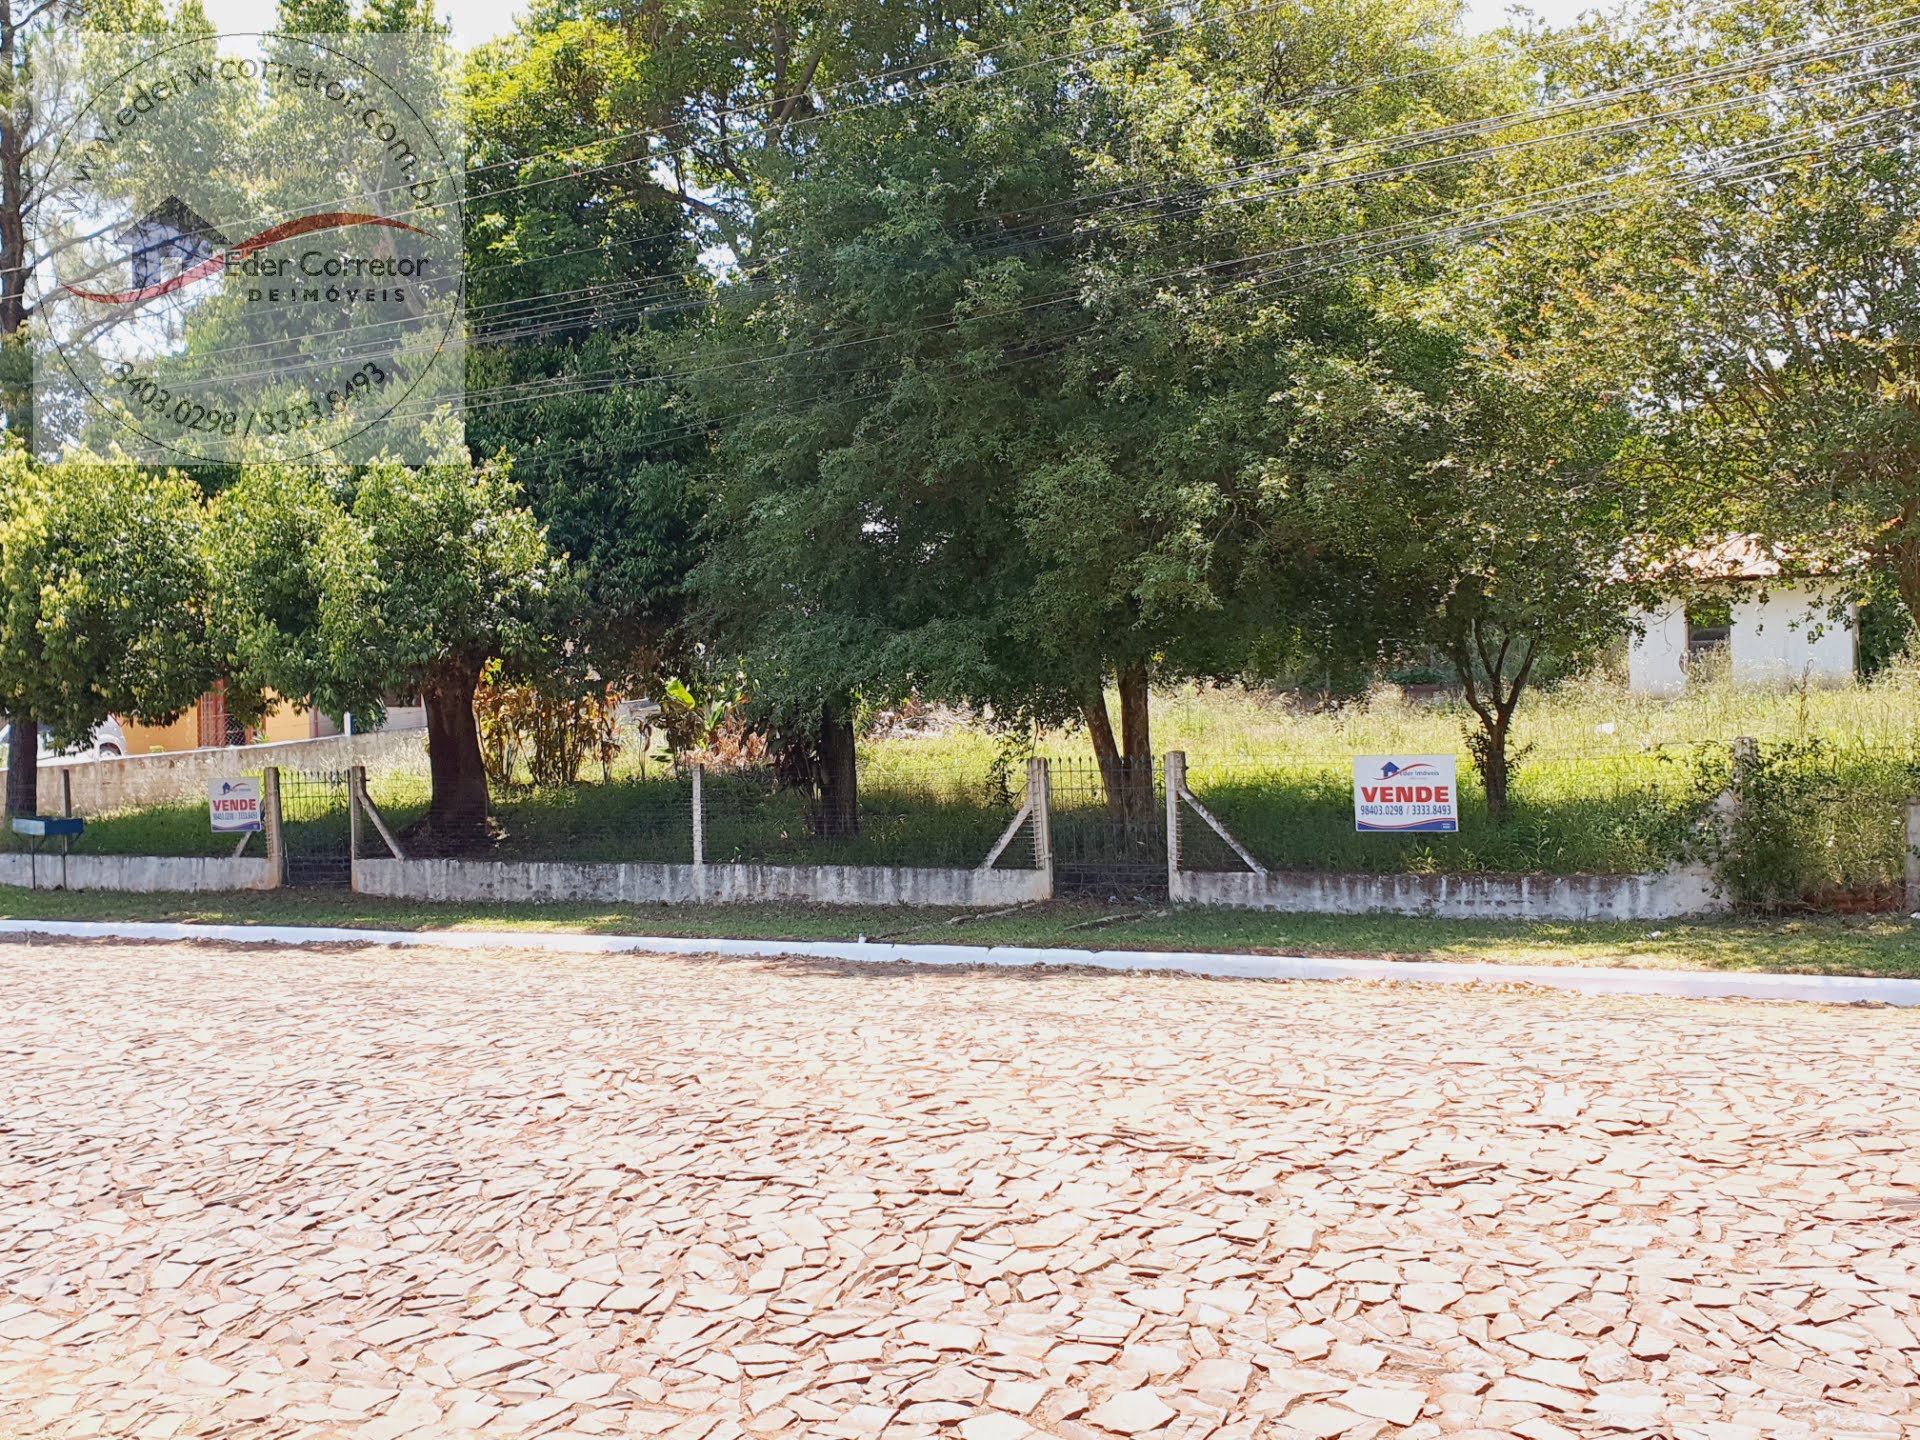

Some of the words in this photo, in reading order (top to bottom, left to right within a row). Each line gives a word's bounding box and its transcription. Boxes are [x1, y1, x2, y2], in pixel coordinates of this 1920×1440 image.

[1361, 786, 1450, 803] VENDE
[212, 799, 257, 812] VENDE
[1360, 805, 1404, 816] 98403.0298
[1412, 805, 1452, 816] 3333.8493
